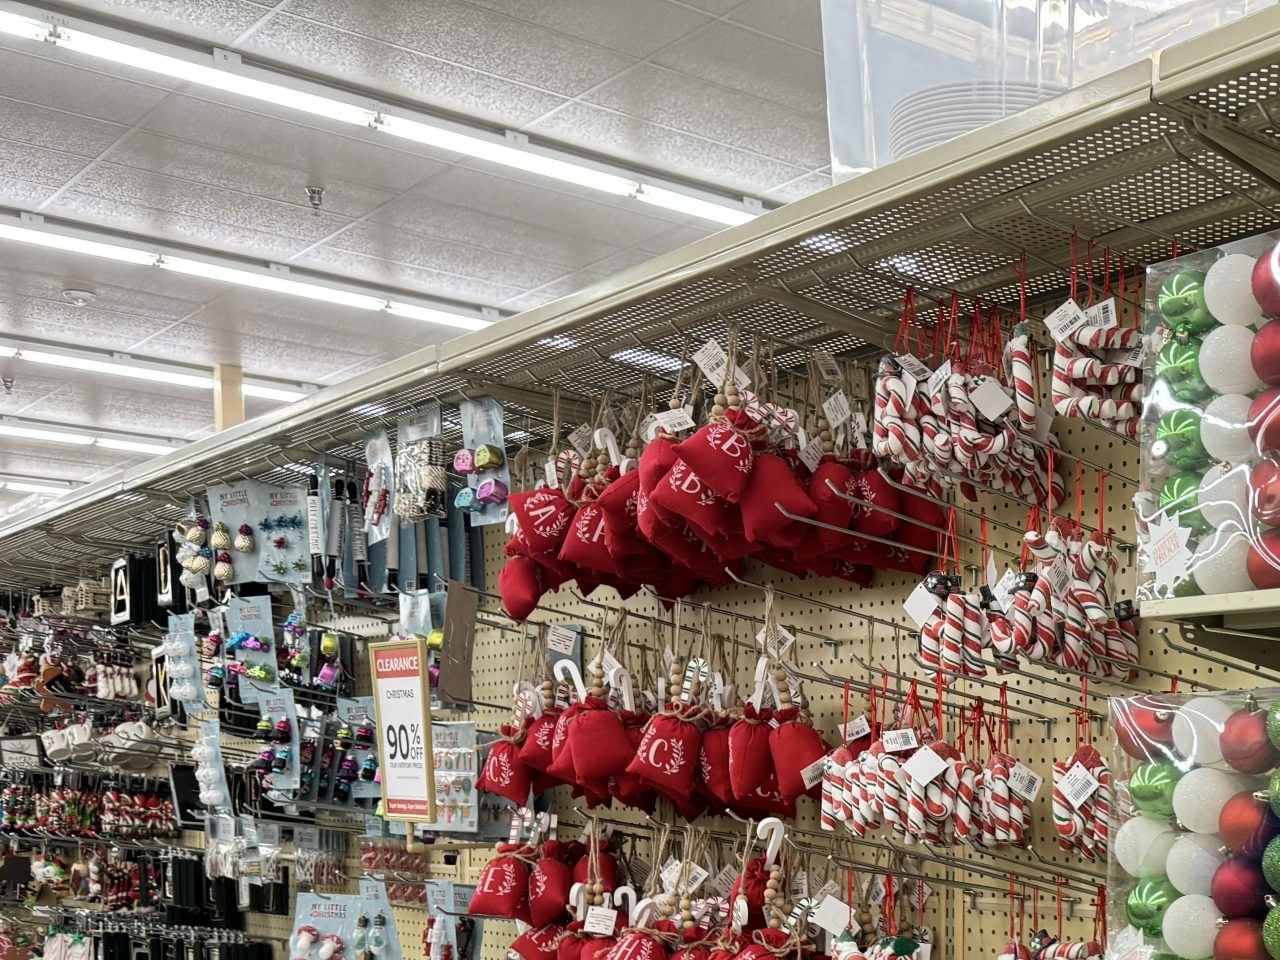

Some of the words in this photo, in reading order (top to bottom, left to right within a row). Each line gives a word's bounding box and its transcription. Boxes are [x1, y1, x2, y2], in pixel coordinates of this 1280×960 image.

[721, 432, 748, 458] B
[528, 504, 557, 527] A
[377, 656, 419, 672] CLEARANCE
[386, 689, 414, 699] CHRISTMAS
[410, 747, 423, 760] OFF
[648, 738, 668, 768] C
[489, 756, 499, 782] C
[483, 867, 501, 893] E
